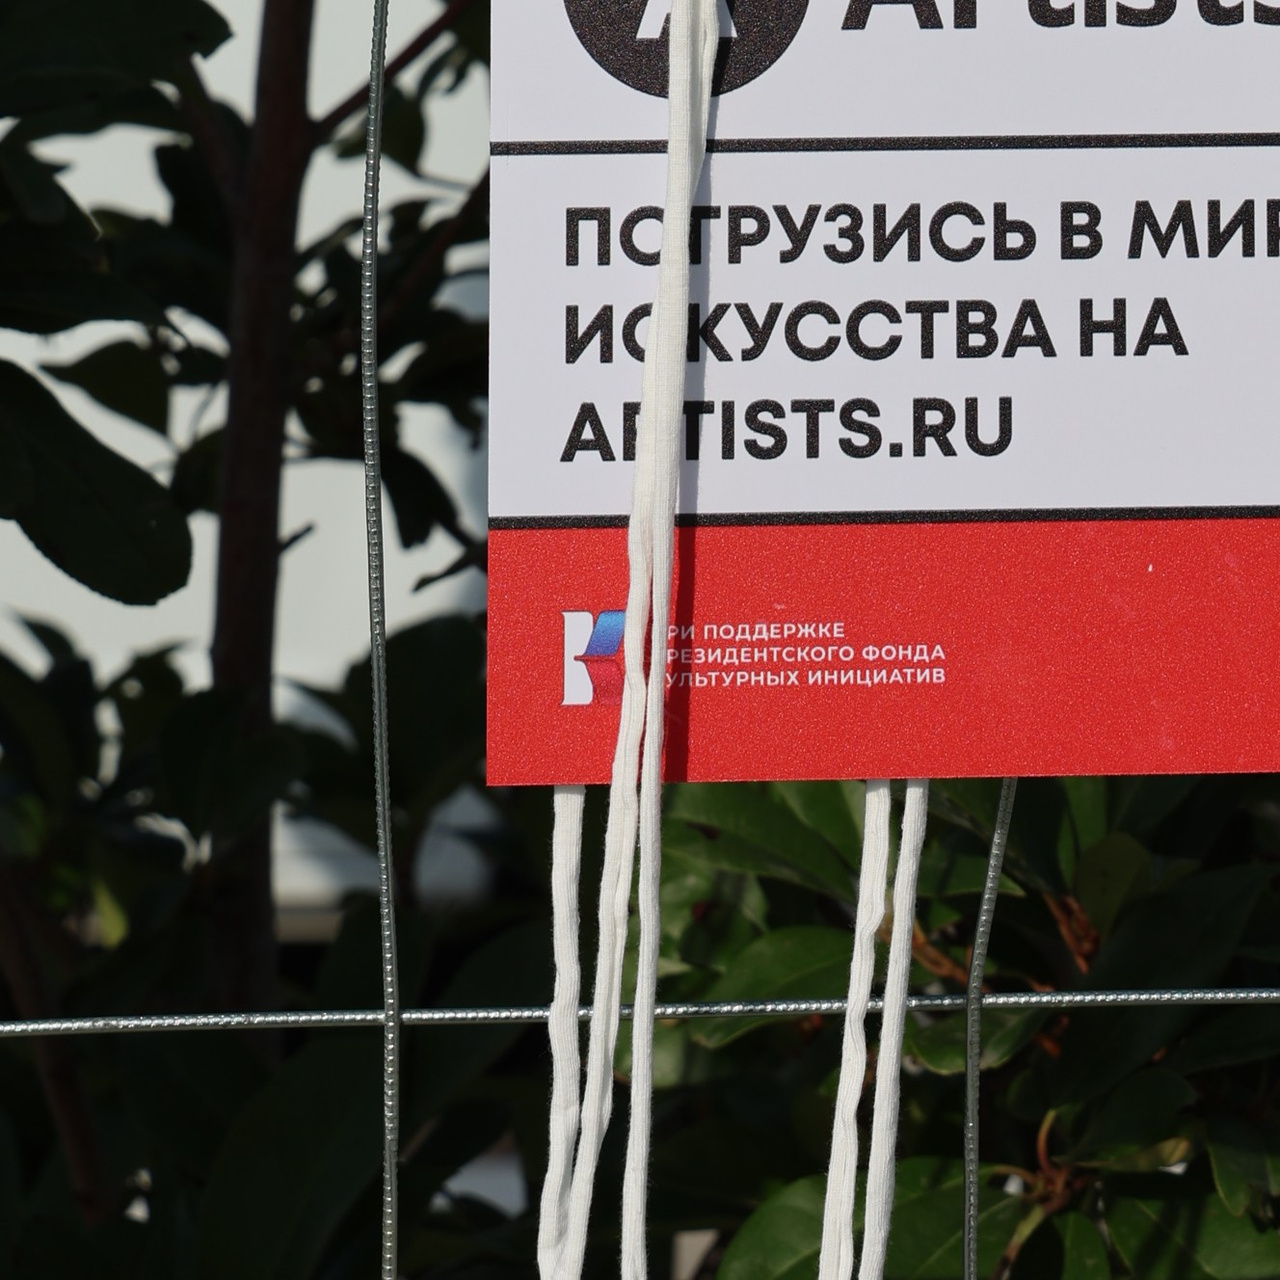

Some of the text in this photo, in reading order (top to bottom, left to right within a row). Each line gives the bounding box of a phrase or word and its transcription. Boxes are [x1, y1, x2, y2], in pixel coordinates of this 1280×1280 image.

[1060, 201, 1104, 261] В
[1079, 297, 1190, 358] НА
[703, 622, 845, 642] ПОДДЕРЖКЕ
[665, 644, 946, 666] РЕЗИДЕНТСКОГО ФОНДА
[665, 667, 946, 688] УЛЬТУРНЫХ ИНИЦИАТИВ
